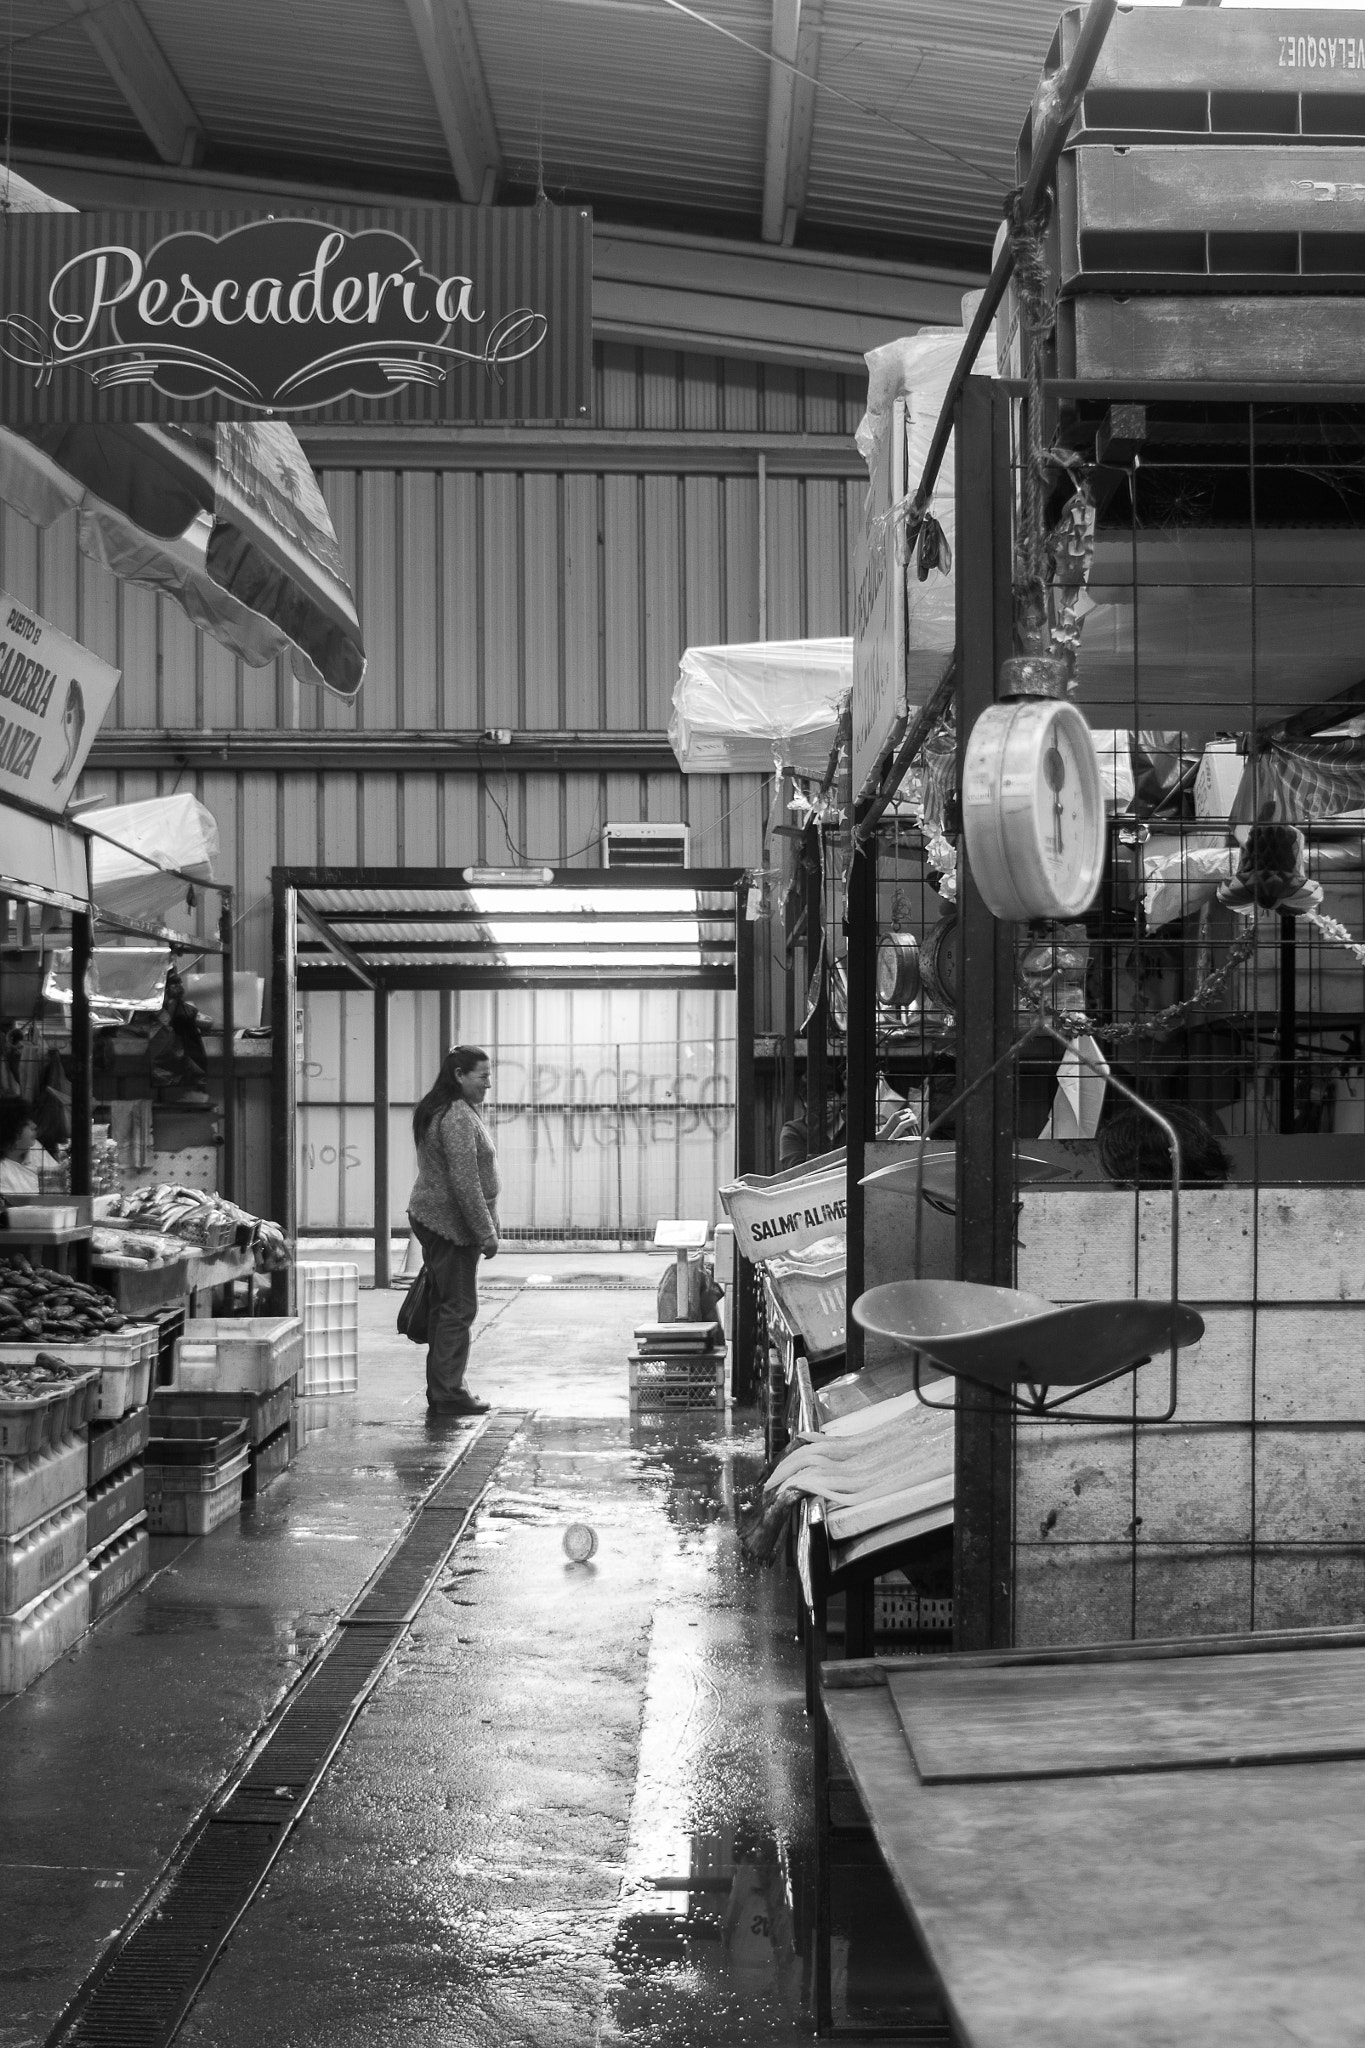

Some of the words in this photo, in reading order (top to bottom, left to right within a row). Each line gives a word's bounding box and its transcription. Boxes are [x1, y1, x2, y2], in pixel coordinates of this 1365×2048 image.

[1278, 34, 1365, 69] VELASQUEZ
[49, 233, 486, 351] Pescadería
[6, 608, 36, 641] PUESTO
